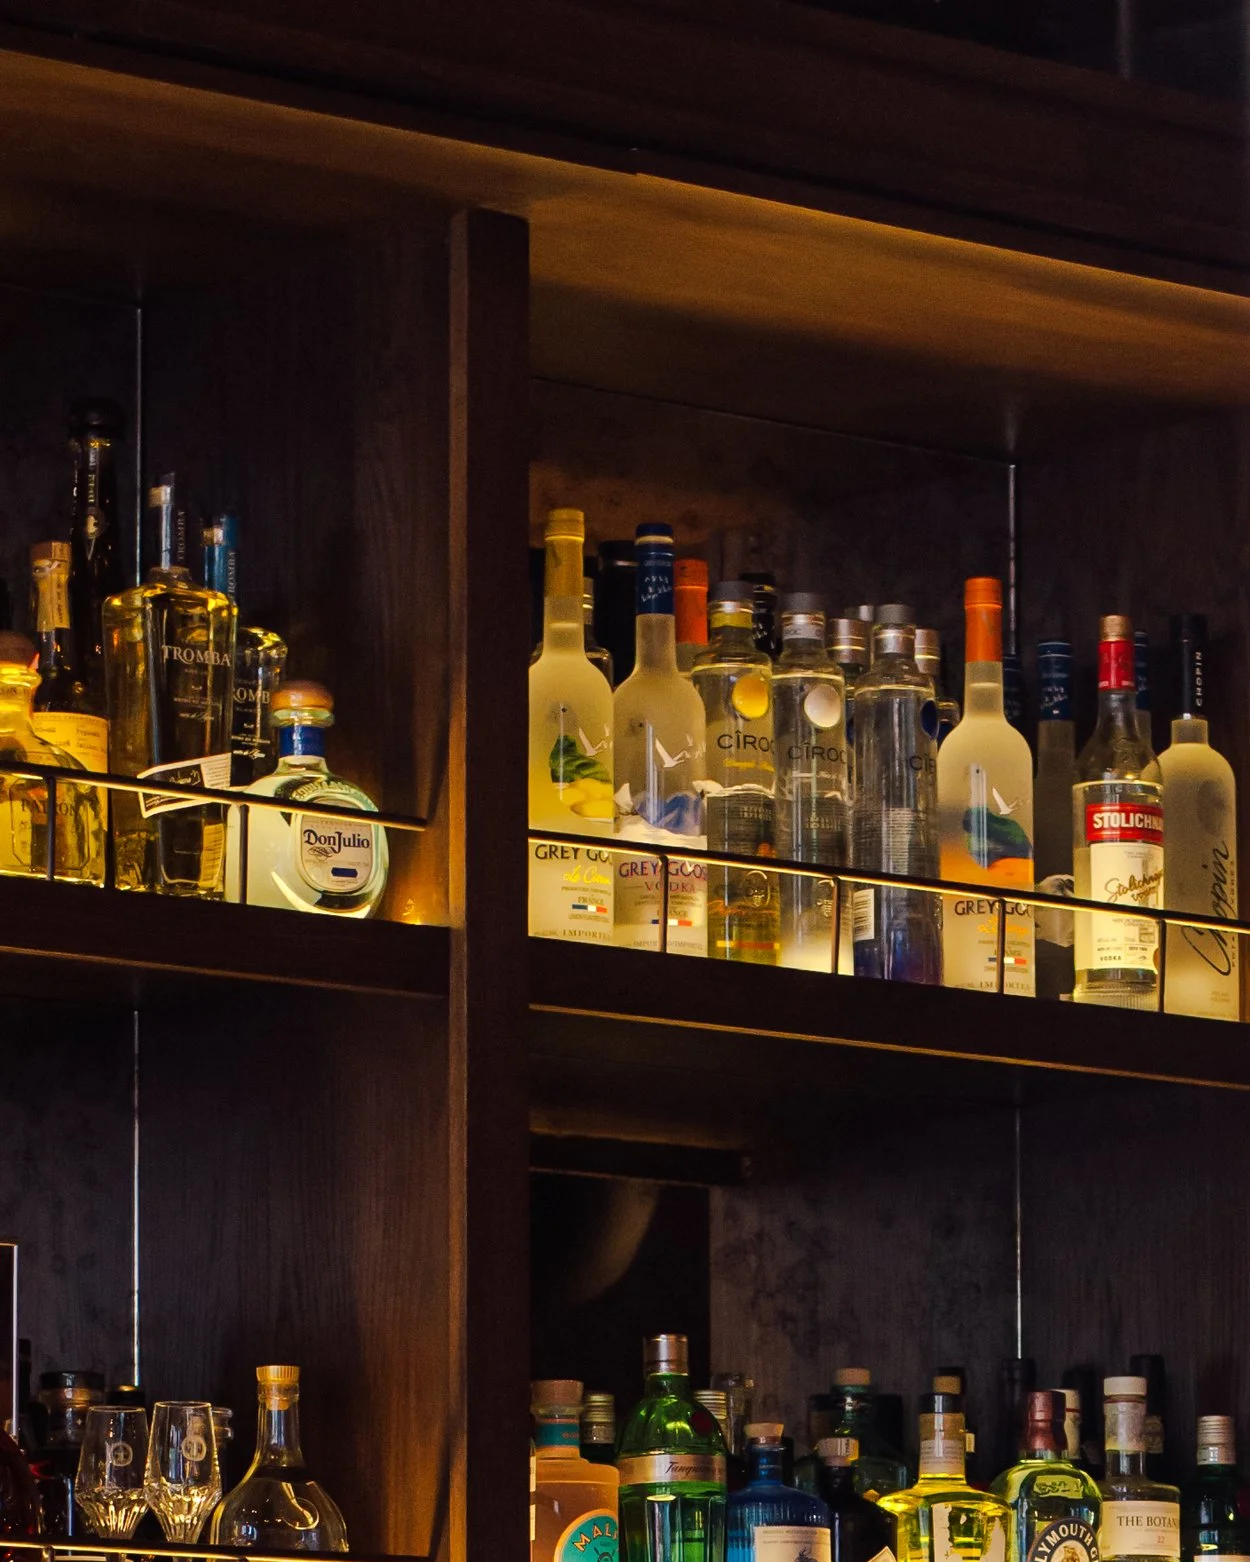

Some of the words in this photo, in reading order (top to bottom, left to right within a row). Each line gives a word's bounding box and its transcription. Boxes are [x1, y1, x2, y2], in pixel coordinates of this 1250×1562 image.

[161, 645, 231, 667] TROMBA
[1195, 651, 1203, 706] CHOPIN
[716, 730, 775, 755] CÎRO
[534, 844, 583, 861] GREY
[619, 861, 659, 878] GREY
[954, 900, 996, 917] GREY
[1117, 1515, 1143, 1527] THE
